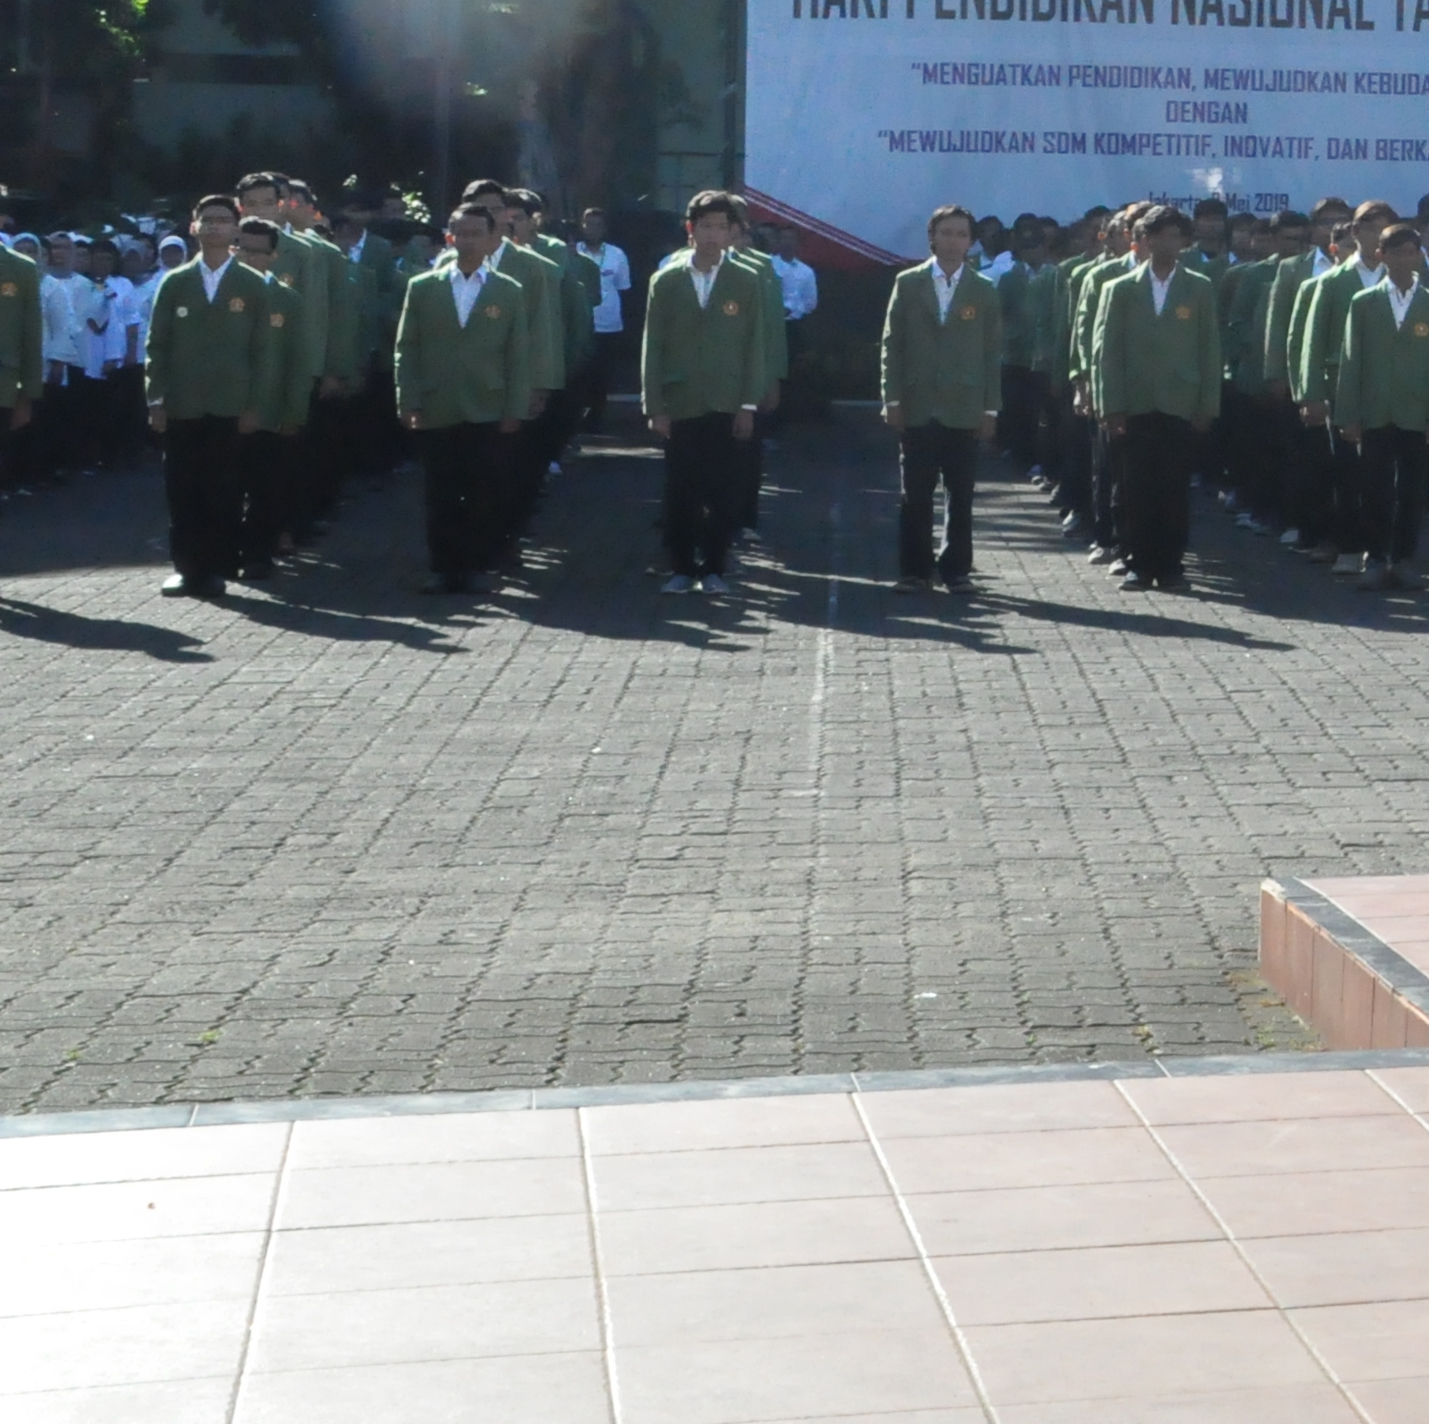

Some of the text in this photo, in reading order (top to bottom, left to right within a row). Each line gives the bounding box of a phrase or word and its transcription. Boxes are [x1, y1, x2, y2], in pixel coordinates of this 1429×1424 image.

[911, 62, 1061, 87] “MENGUATKAN
[1068, 64, 1197, 92] PENDIDIKAN,
[1203, 68, 1347, 94] MEWUJUDKAN
[1165, 100, 1248, 125] DENGAN
[877, 130, 1035, 154] “MEWUJUDKAN
[1043, 131, 1087, 155] SDM
[1094, 132, 1216, 159] KOMPETITIF,
[1224, 135, 1320, 162] INOVATIF,
[1326, 137, 1368, 161] DAN
[1254, 192, 1290, 212] 2019
